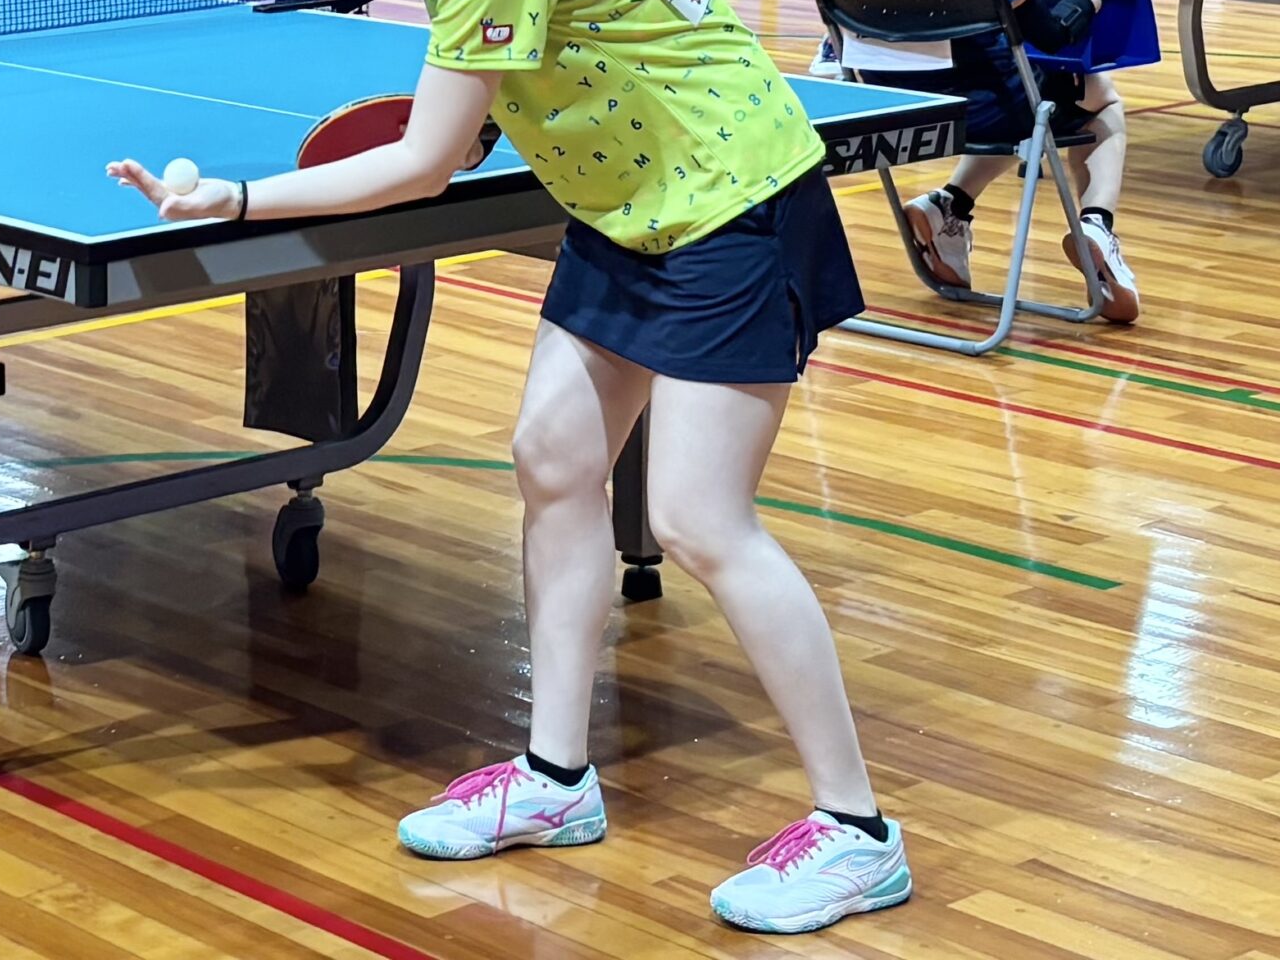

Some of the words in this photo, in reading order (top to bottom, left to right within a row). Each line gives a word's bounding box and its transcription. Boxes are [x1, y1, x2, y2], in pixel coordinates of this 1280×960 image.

[528, 12, 540, 26] Y
[595, 60, 608, 74] P
[635, 61, 650, 75] Y
[576, 76, 593, 89] Y
[607, 98, 619, 112] P
[748, 93, 761, 106] 8
[716, 125, 733, 141] K
[552, 145, 566, 157] 2
[592, 151, 608, 163] R
[633, 153, 651, 169] M
[622, 202, 632, 216] 8
